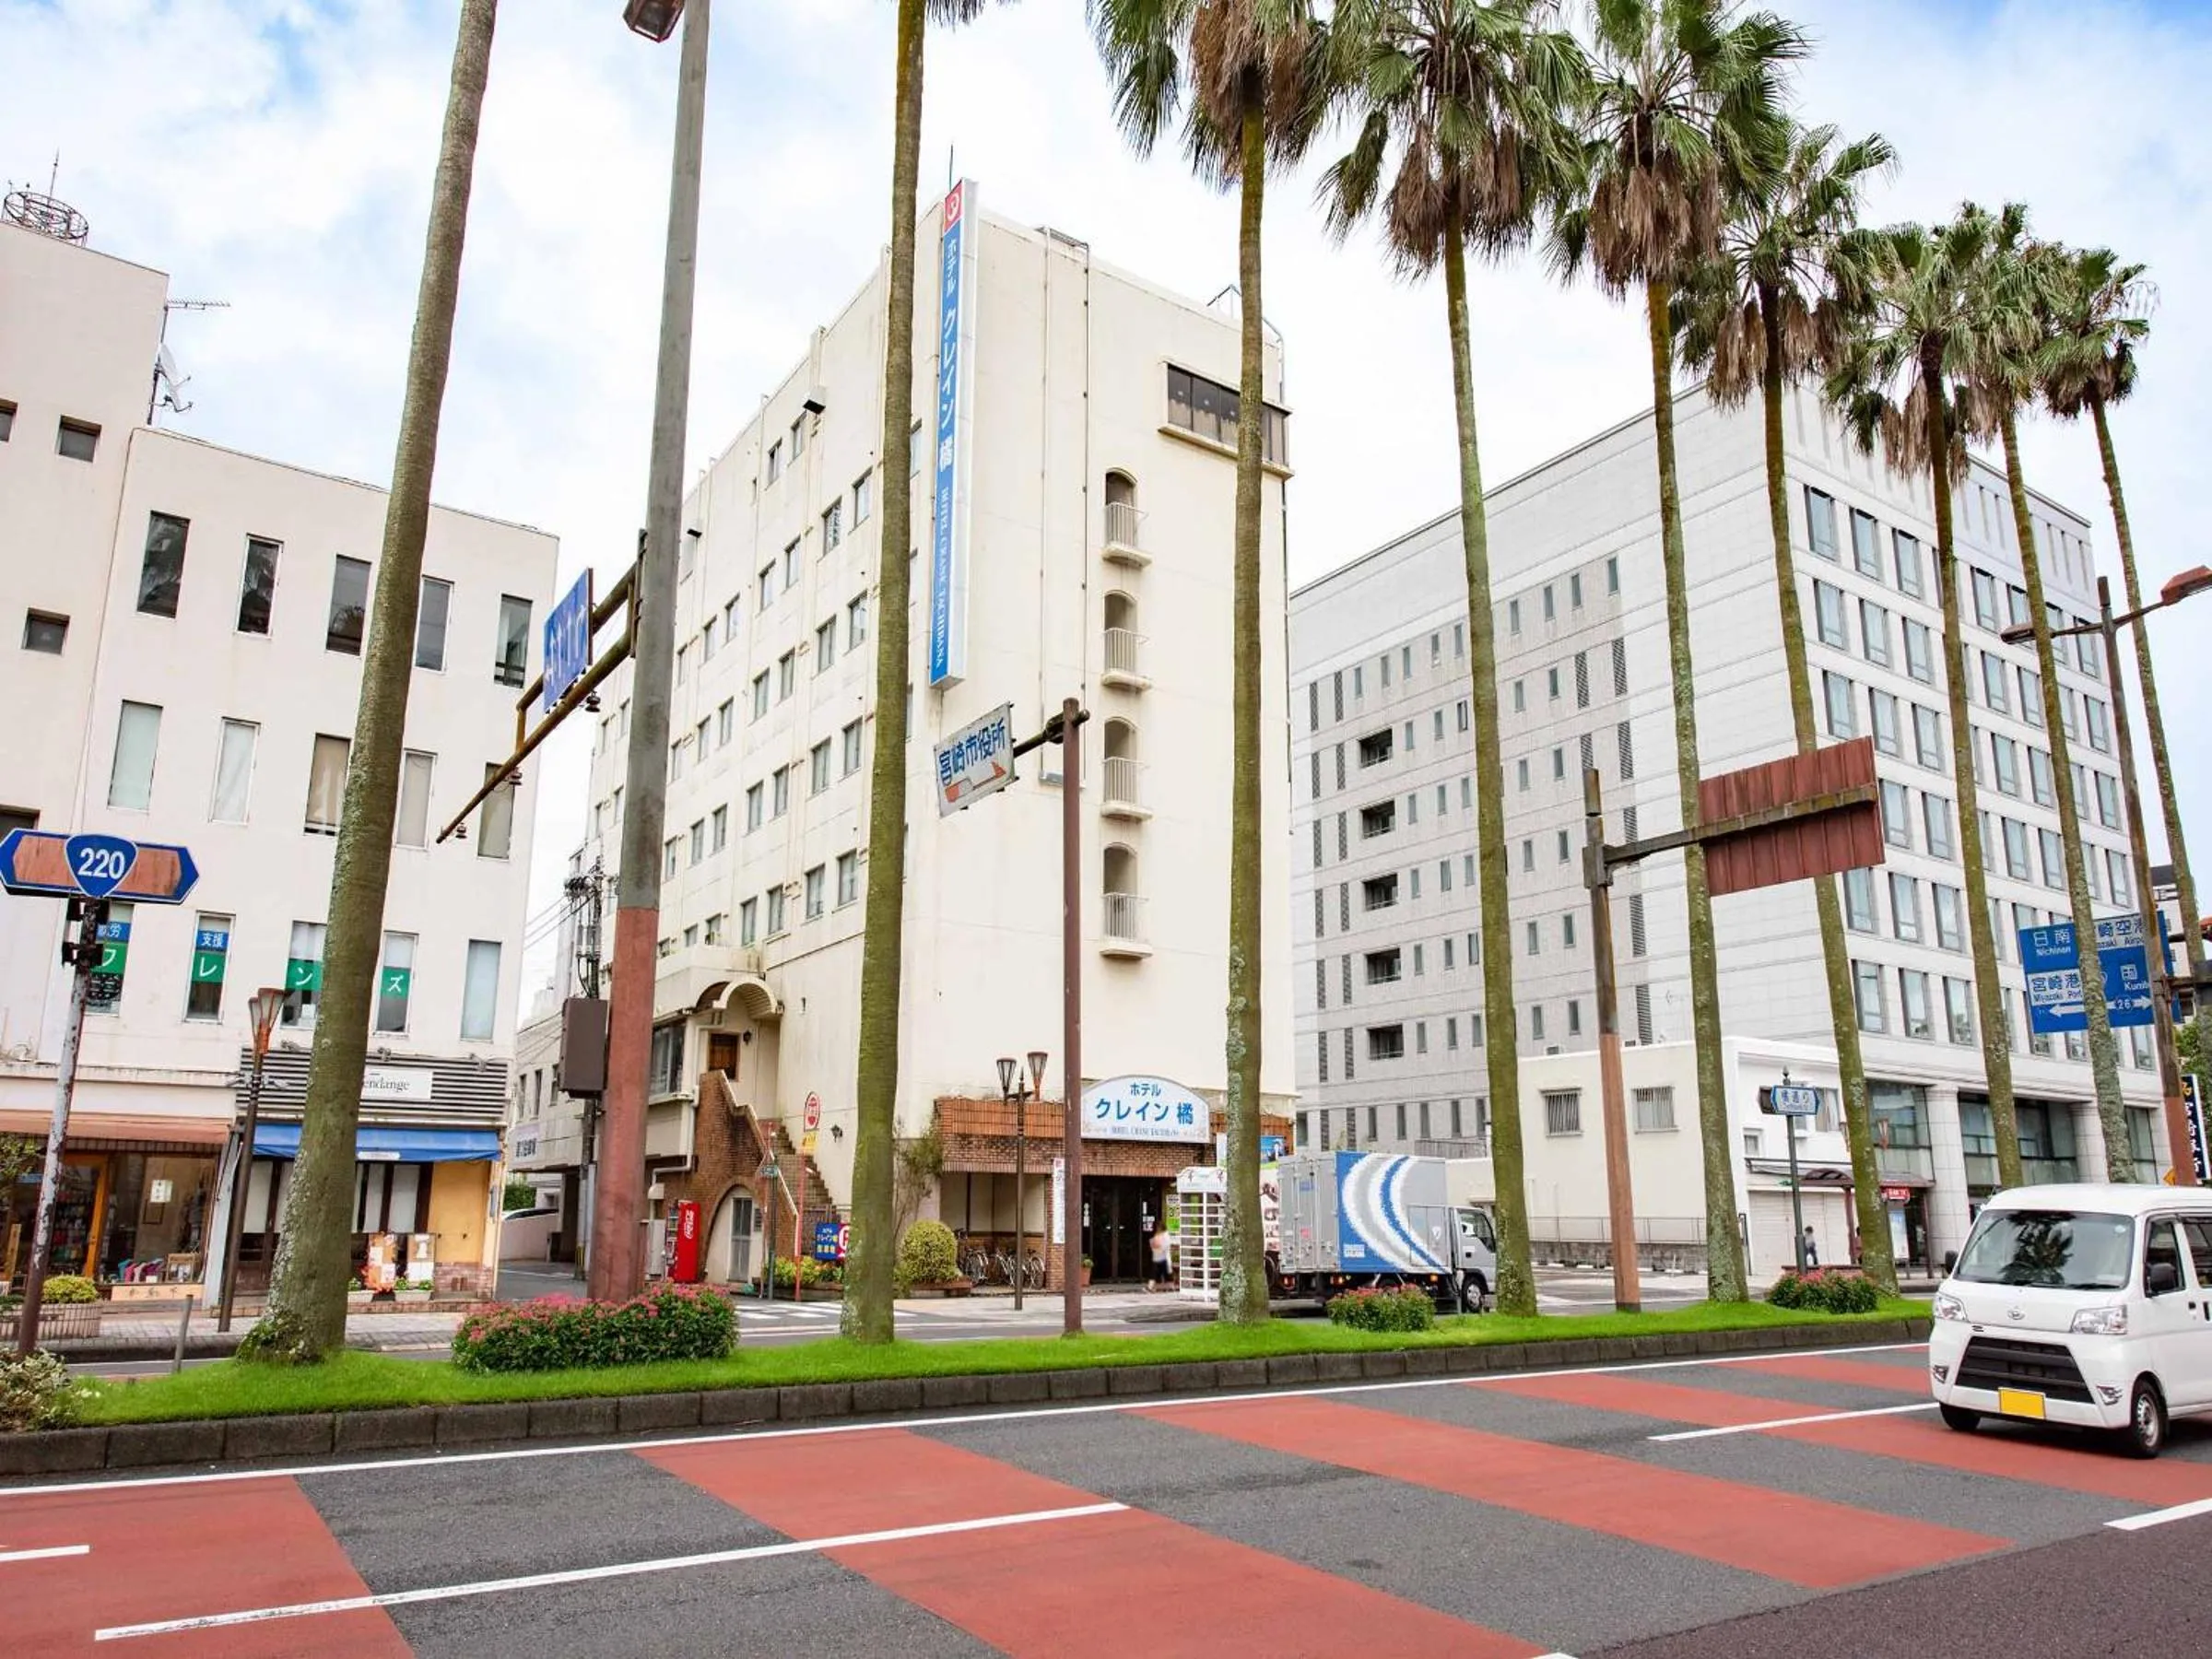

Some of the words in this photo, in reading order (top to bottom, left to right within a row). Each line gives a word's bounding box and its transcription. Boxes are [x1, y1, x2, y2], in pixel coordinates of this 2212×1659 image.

[946, 239, 958, 298] ホテル
[938, 717, 1006, 786] 宮崎市役所
[77, 847, 125, 880] 220
[201, 933, 224, 947] 支援
[2034, 930, 2071, 947] 日南
[2036, 947, 2072, 956] Nichinan
[2032, 973, 2080, 992] 宮崎港
[364, 1077, 411, 1093] endange
[1130, 1082, 1161, 1097] ホテル
